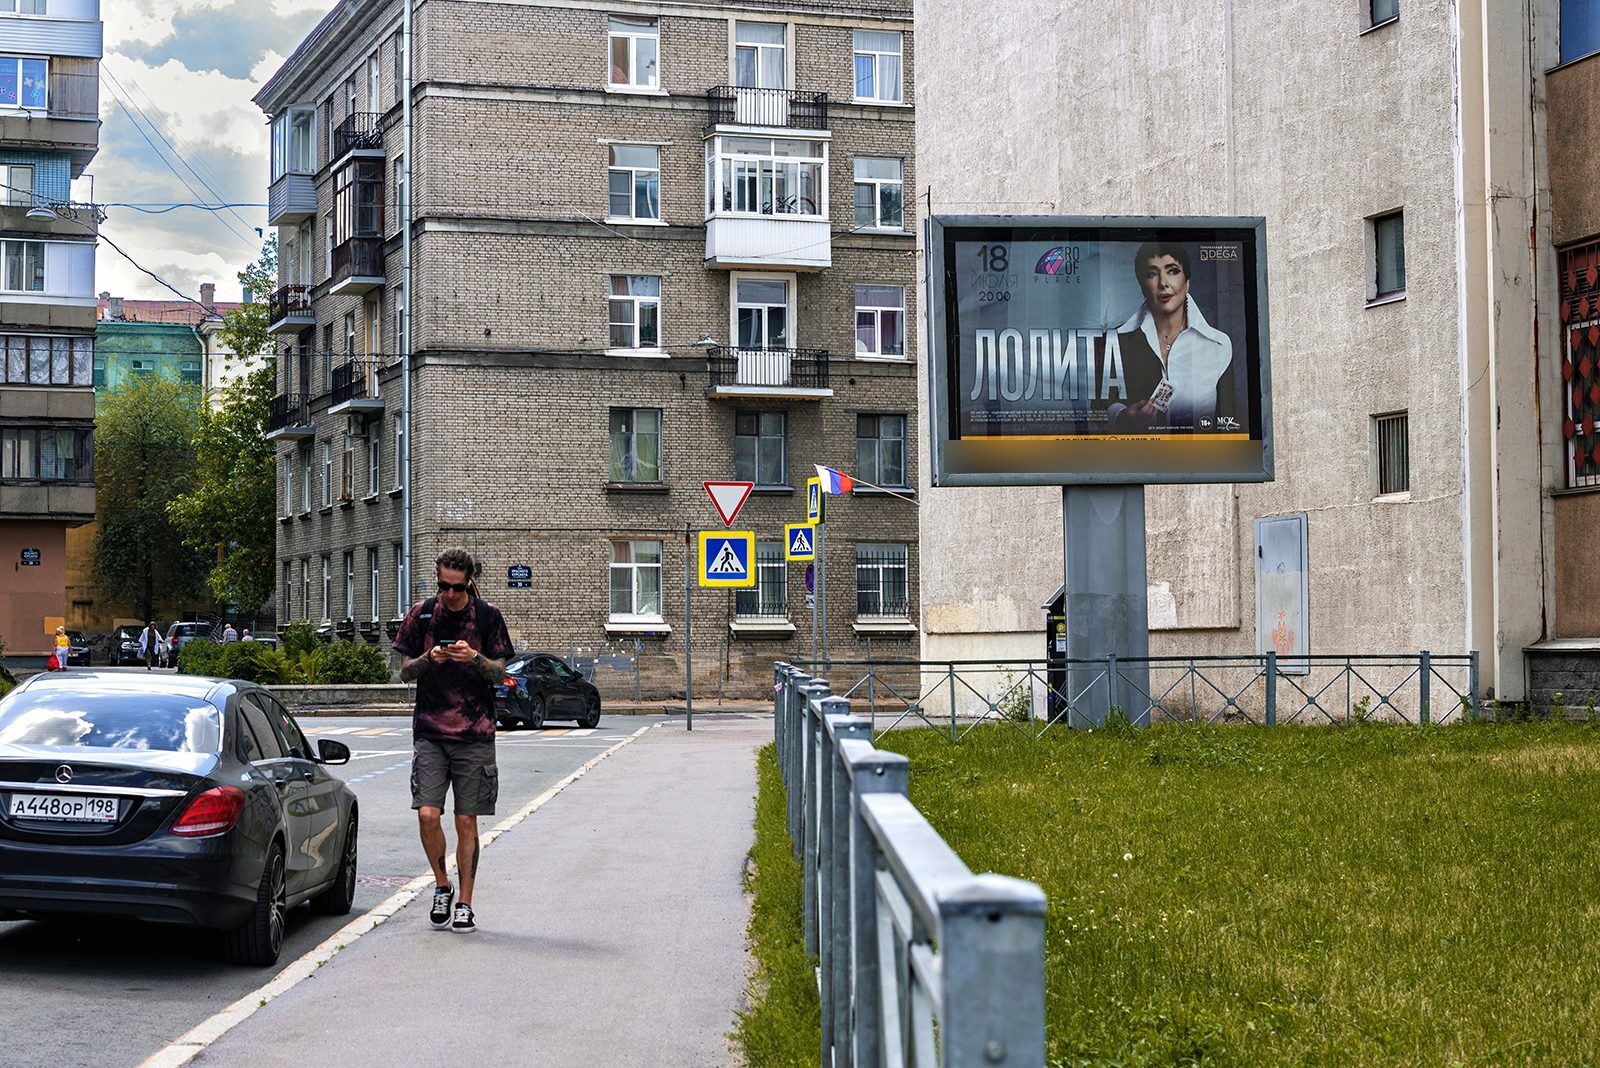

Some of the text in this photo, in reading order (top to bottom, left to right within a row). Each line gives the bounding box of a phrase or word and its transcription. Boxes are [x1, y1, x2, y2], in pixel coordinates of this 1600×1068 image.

[977, 244, 1008, 272] 18
[970, 273, 1018, 288] ИЮЛЯ
[1034, 275, 1081, 284] PLACE
[970, 328, 1128, 402] ЛОЛИТА
[1200, 419, 1212, 427] 18+
[88, 799, 113, 813] 198
